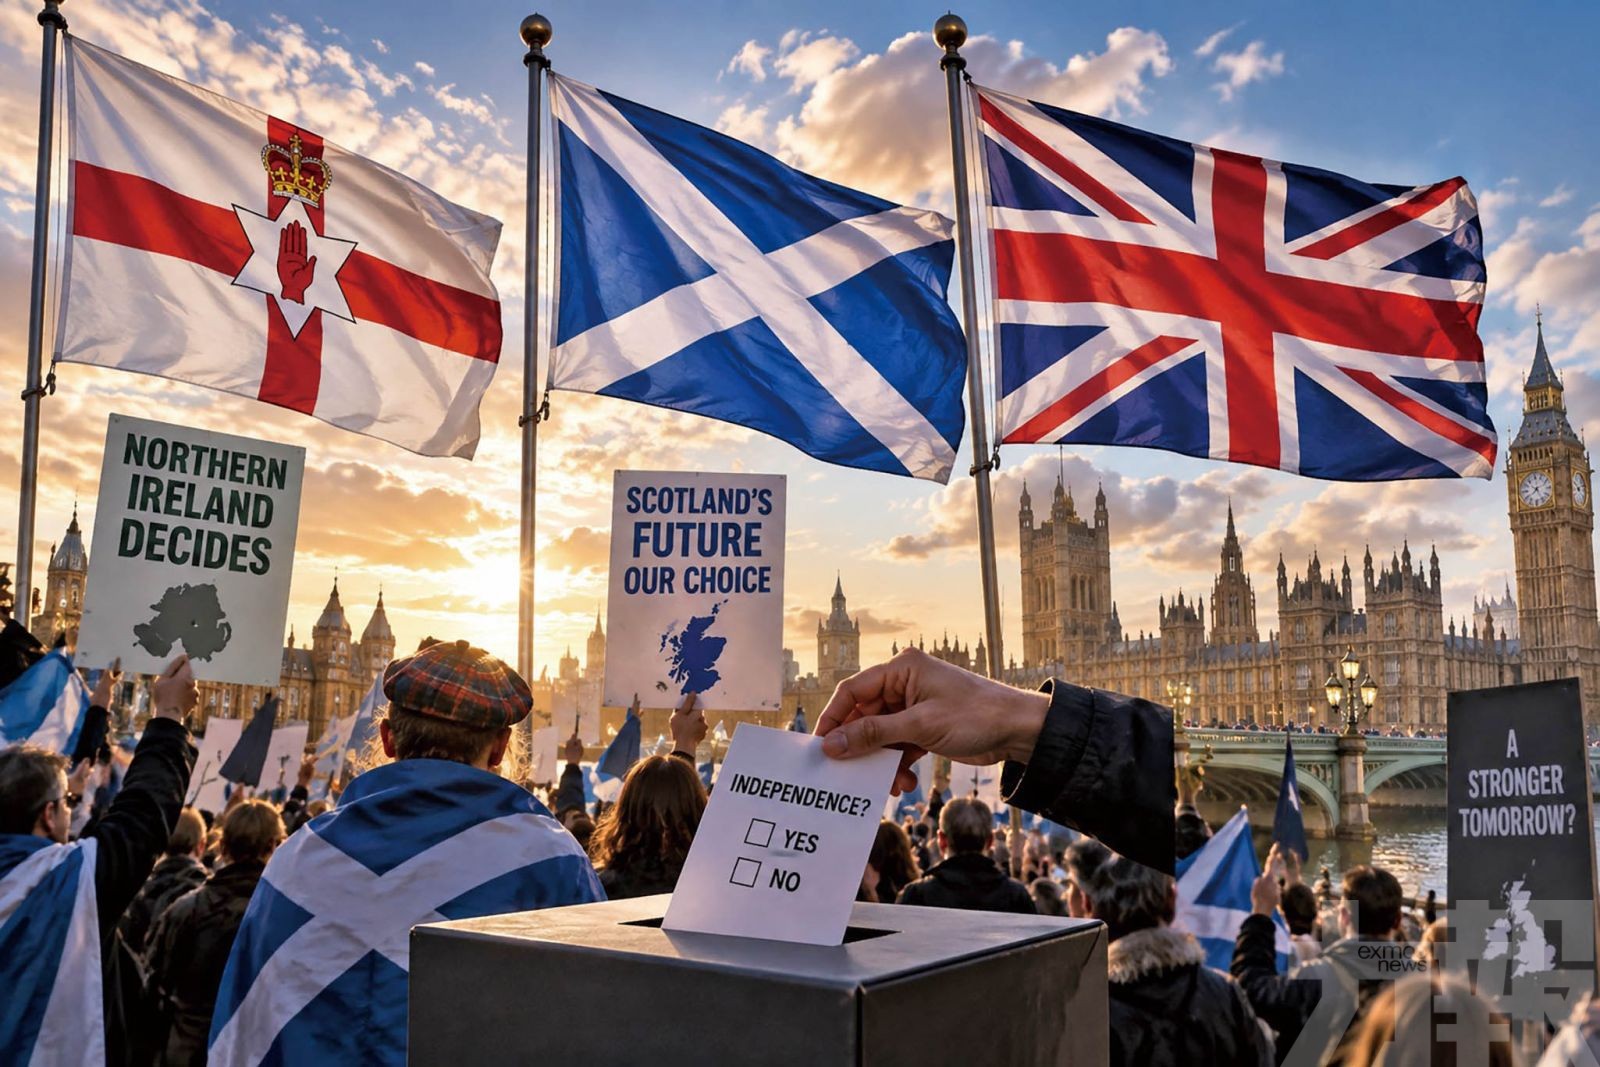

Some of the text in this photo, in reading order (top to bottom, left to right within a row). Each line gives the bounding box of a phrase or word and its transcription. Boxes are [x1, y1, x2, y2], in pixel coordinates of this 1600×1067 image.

[123, 433, 287, 489] NORTHERN
[128, 474, 273, 528] IRELAND
[627, 487, 772, 515] SCOTLAND'S
[118, 518, 272, 575] DECIDES
[633, 522, 762, 558] FUTURE
[625, 566, 771, 594] OUR CHOICE
[1506, 729, 1519, 758] A
[730, 774, 871, 816] INDEPENDENCE?
[1469, 765, 1564, 798] STRONGER
[1459, 804, 1575, 837] TOMORROW?
[785, 830, 819, 853] YES
[769, 869, 800, 892] NO
